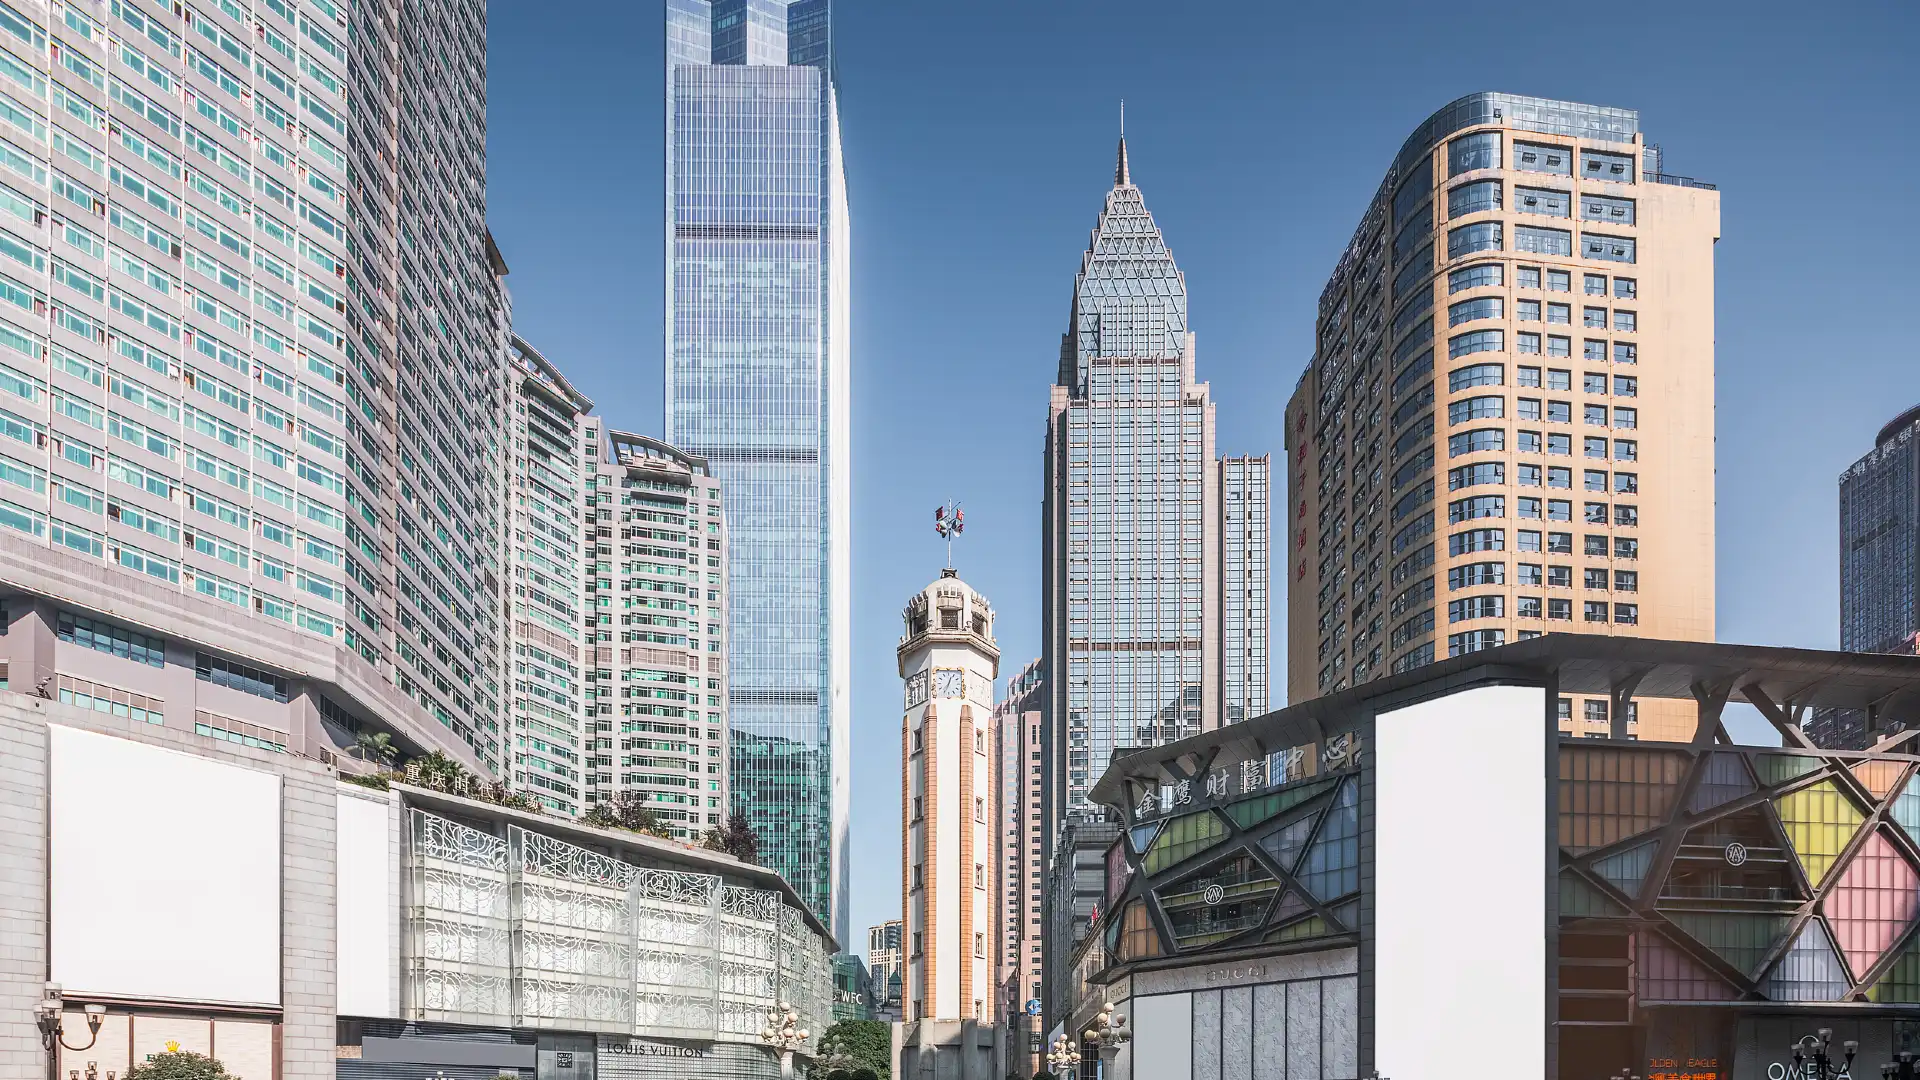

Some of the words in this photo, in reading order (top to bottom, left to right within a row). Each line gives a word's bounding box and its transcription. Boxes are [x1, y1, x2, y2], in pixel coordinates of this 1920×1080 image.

[1137, 740, 1349, 812] 金鹰财富中心
[1110, 982, 1127, 999] GUCCI
[607, 1043, 645, 1055] LOUIS
[650, 1045, 703, 1058] VUITTON
[1688, 1058, 1717, 1068] EAGLE
[1767, 1062, 1852, 1080] OMEA
